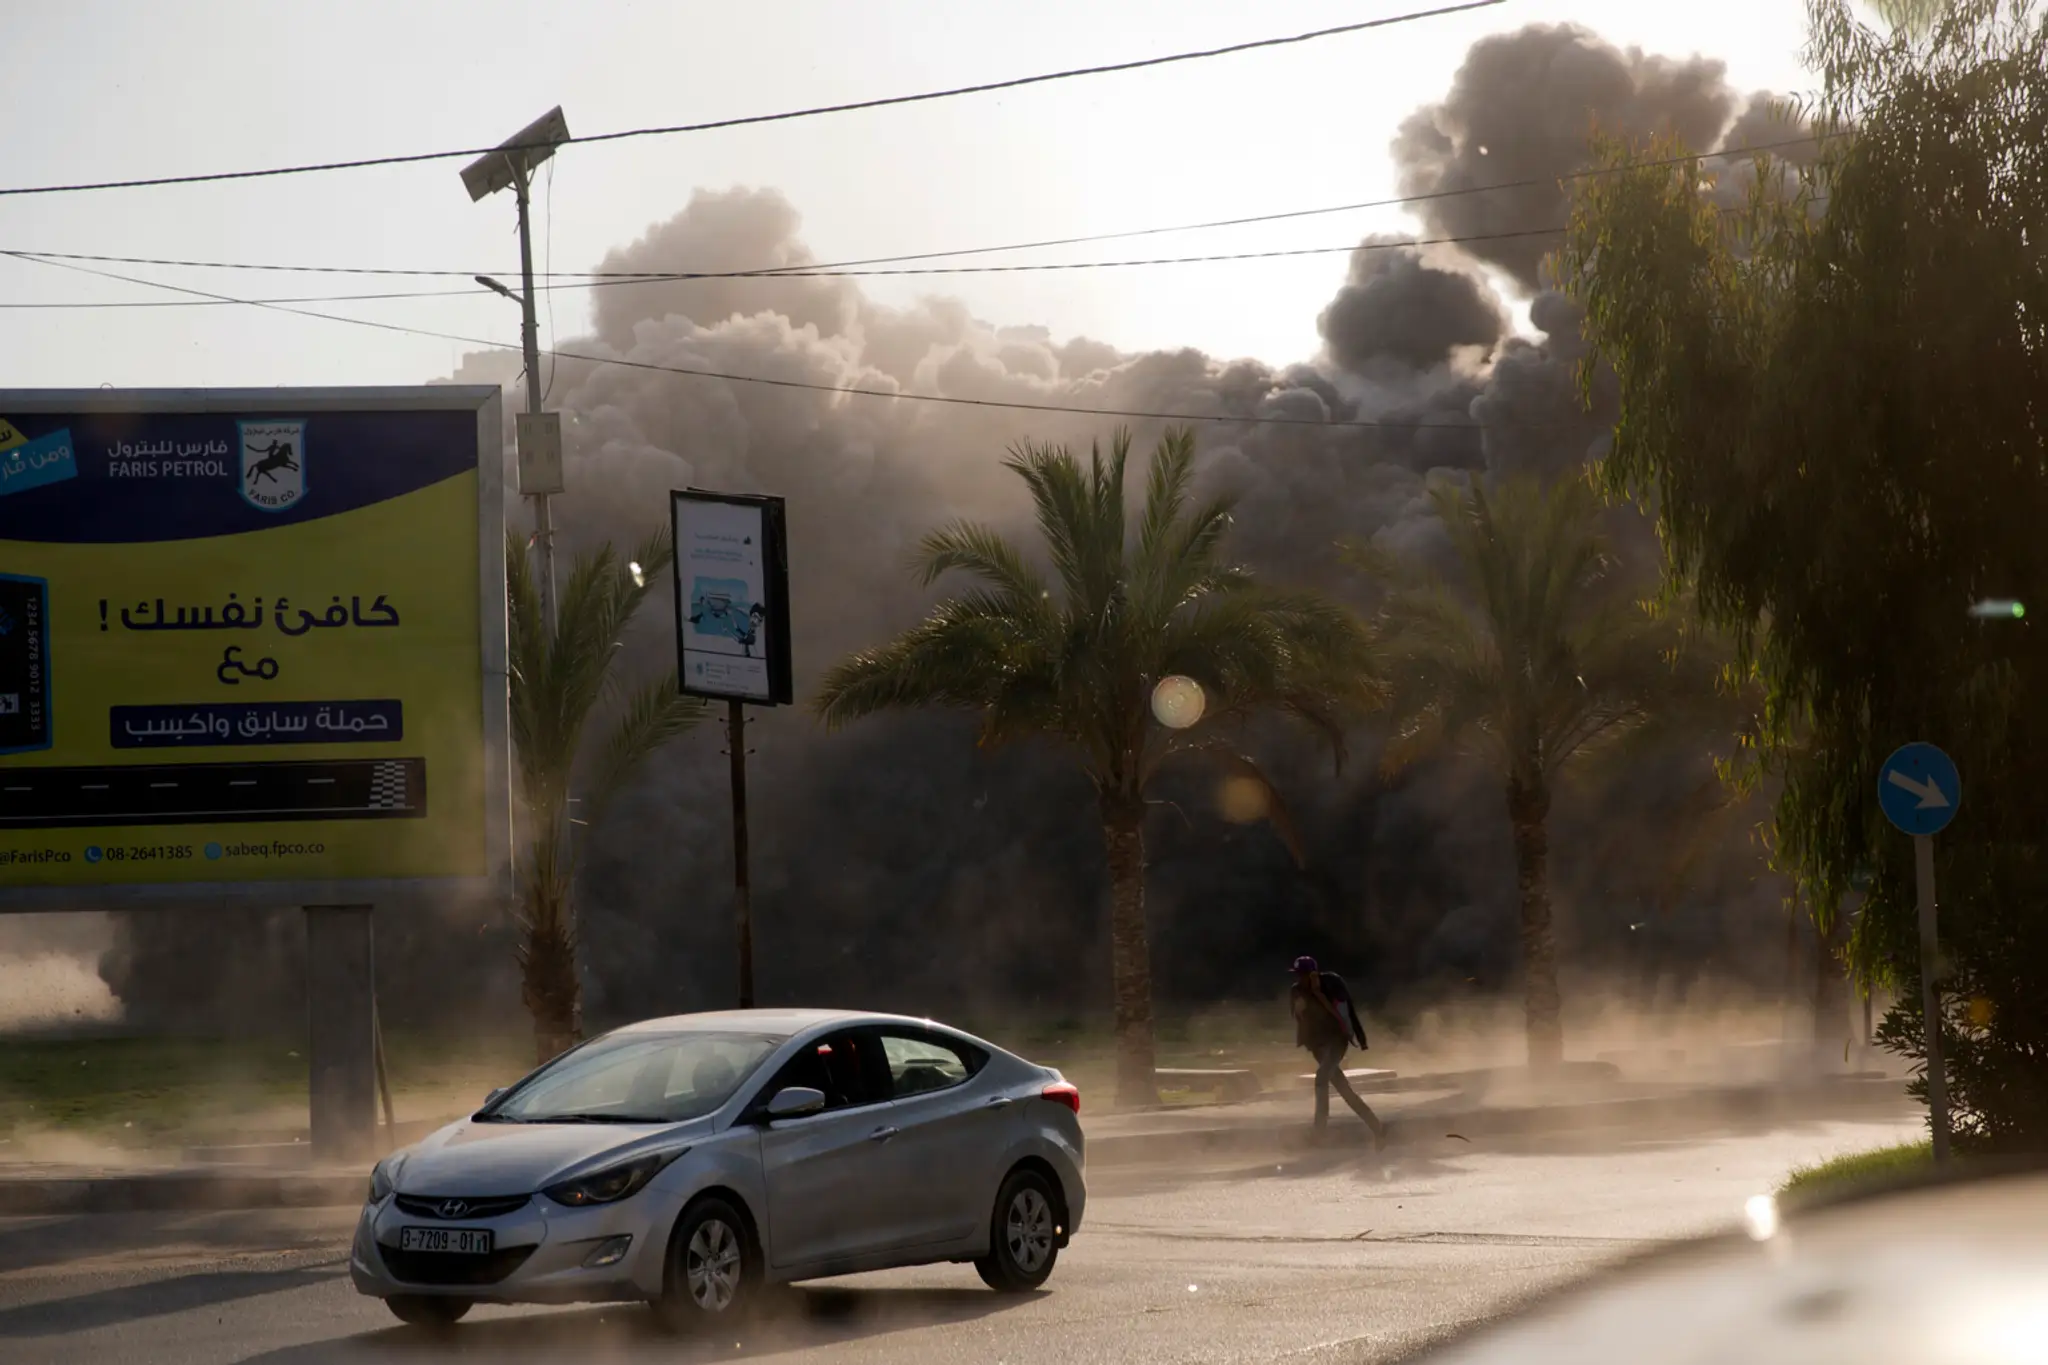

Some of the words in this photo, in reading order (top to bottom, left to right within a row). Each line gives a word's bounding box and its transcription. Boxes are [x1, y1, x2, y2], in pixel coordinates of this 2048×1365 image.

[107, 440, 173, 458] للبترول
[176, 440, 228, 457] فارس
[109, 460, 158, 478] FARIS
[162, 460, 228, 477] PETROL
[26, 596, 38, 626] 1234
[275, 594, 399, 635] كافئ
[27, 629, 39, 661] 5678
[28, 662, 41, 695] 9012
[217, 645, 279, 685] مع
[237, 711, 308, 739] سابق
[315, 706, 389, 732] حملة
[106, 846, 193, 862] 08-2641385
[225, 841, 326, 859] sabeq.fpco.co
